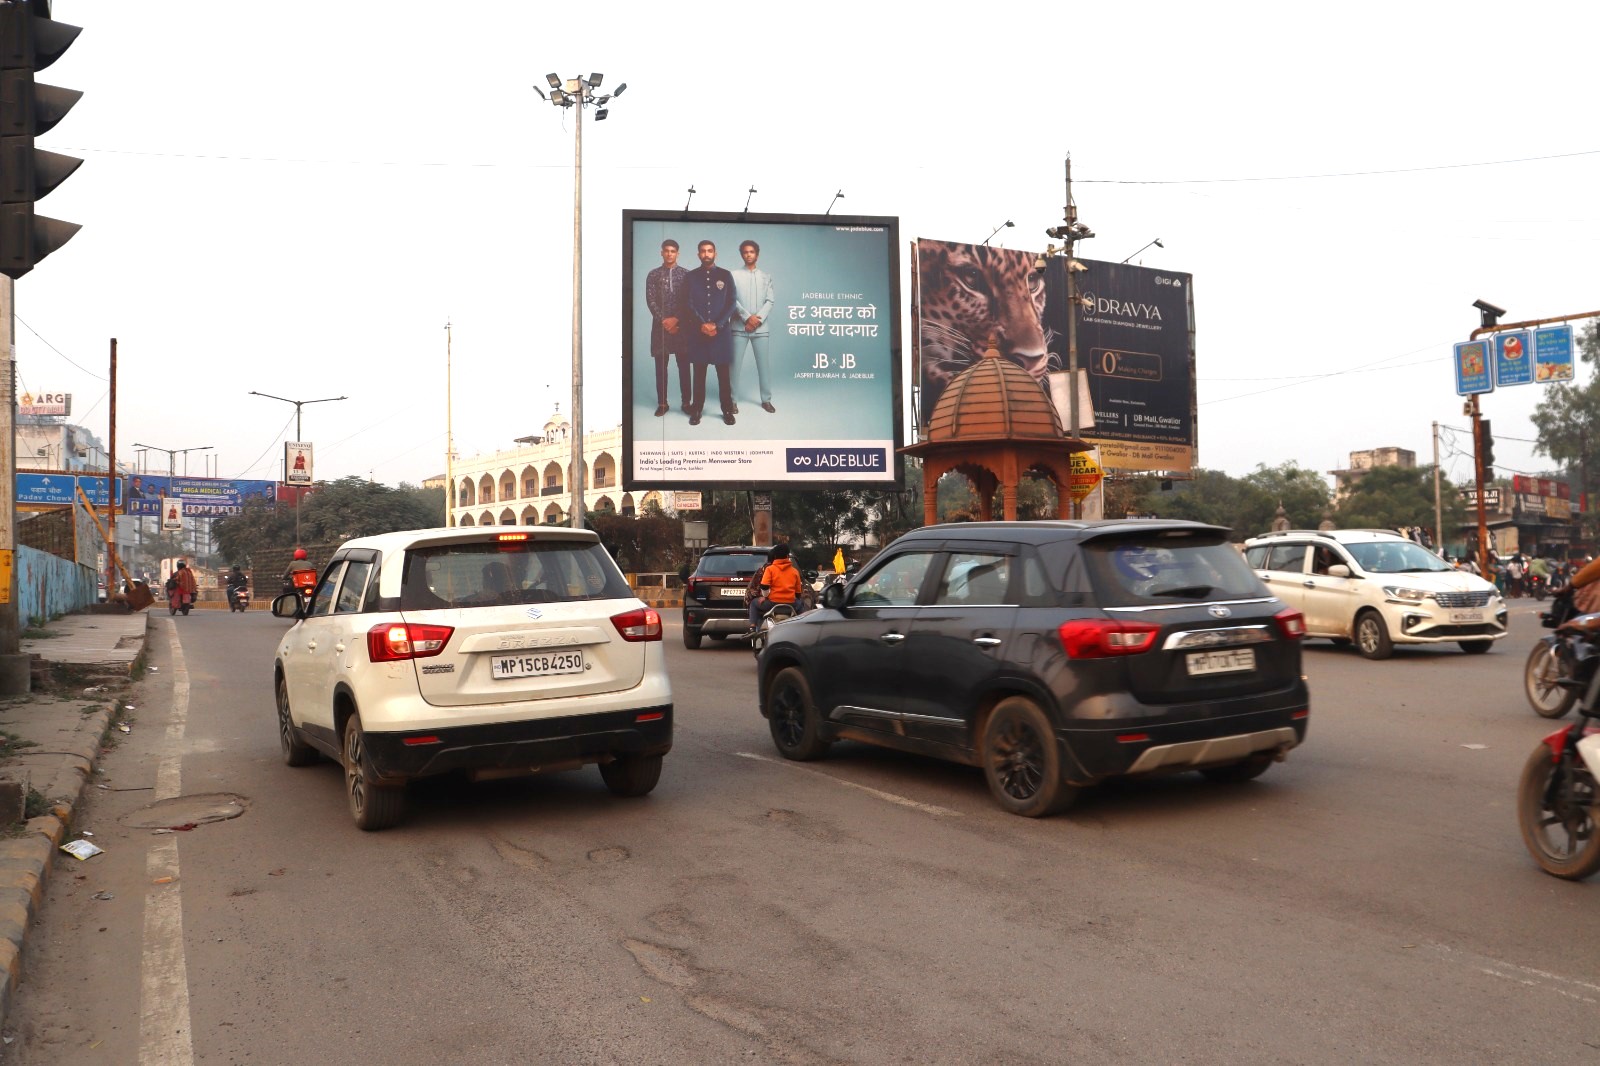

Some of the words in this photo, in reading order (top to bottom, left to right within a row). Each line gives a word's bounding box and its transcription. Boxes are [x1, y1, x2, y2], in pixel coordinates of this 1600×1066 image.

[802, 292, 835, 300] JADEBLUE
[788, 305, 806, 320] हर
[810, 305, 853, 319] अवसर
[856, 303, 876, 319] को
[1098, 297, 1162, 321] DRAVYA
[787, 321, 826, 336] बनाएं
[828, 324, 879, 337] यादगार
[812, 353, 829, 369] JB
[839, 353, 856, 369] JB
[1118, 365, 1137, 374] Making
[36, 393, 64, 404] ARG
[1095, 411, 1119, 419] WELLERS
[1134, 413, 1143, 422] DB
[1159, 416, 1181, 425] Gwalior
[1107, 449, 1128, 458] Gwalior
[1155, 453, 1175, 461] Gwalior
[660, 458, 682, 466] Leading
[200, 487, 222, 495] MEDICAL
[98, 496, 119, 504] Stad
[497, 636, 580, 650] BREZZA
[500, 654, 581, 674] MP15CB4250
